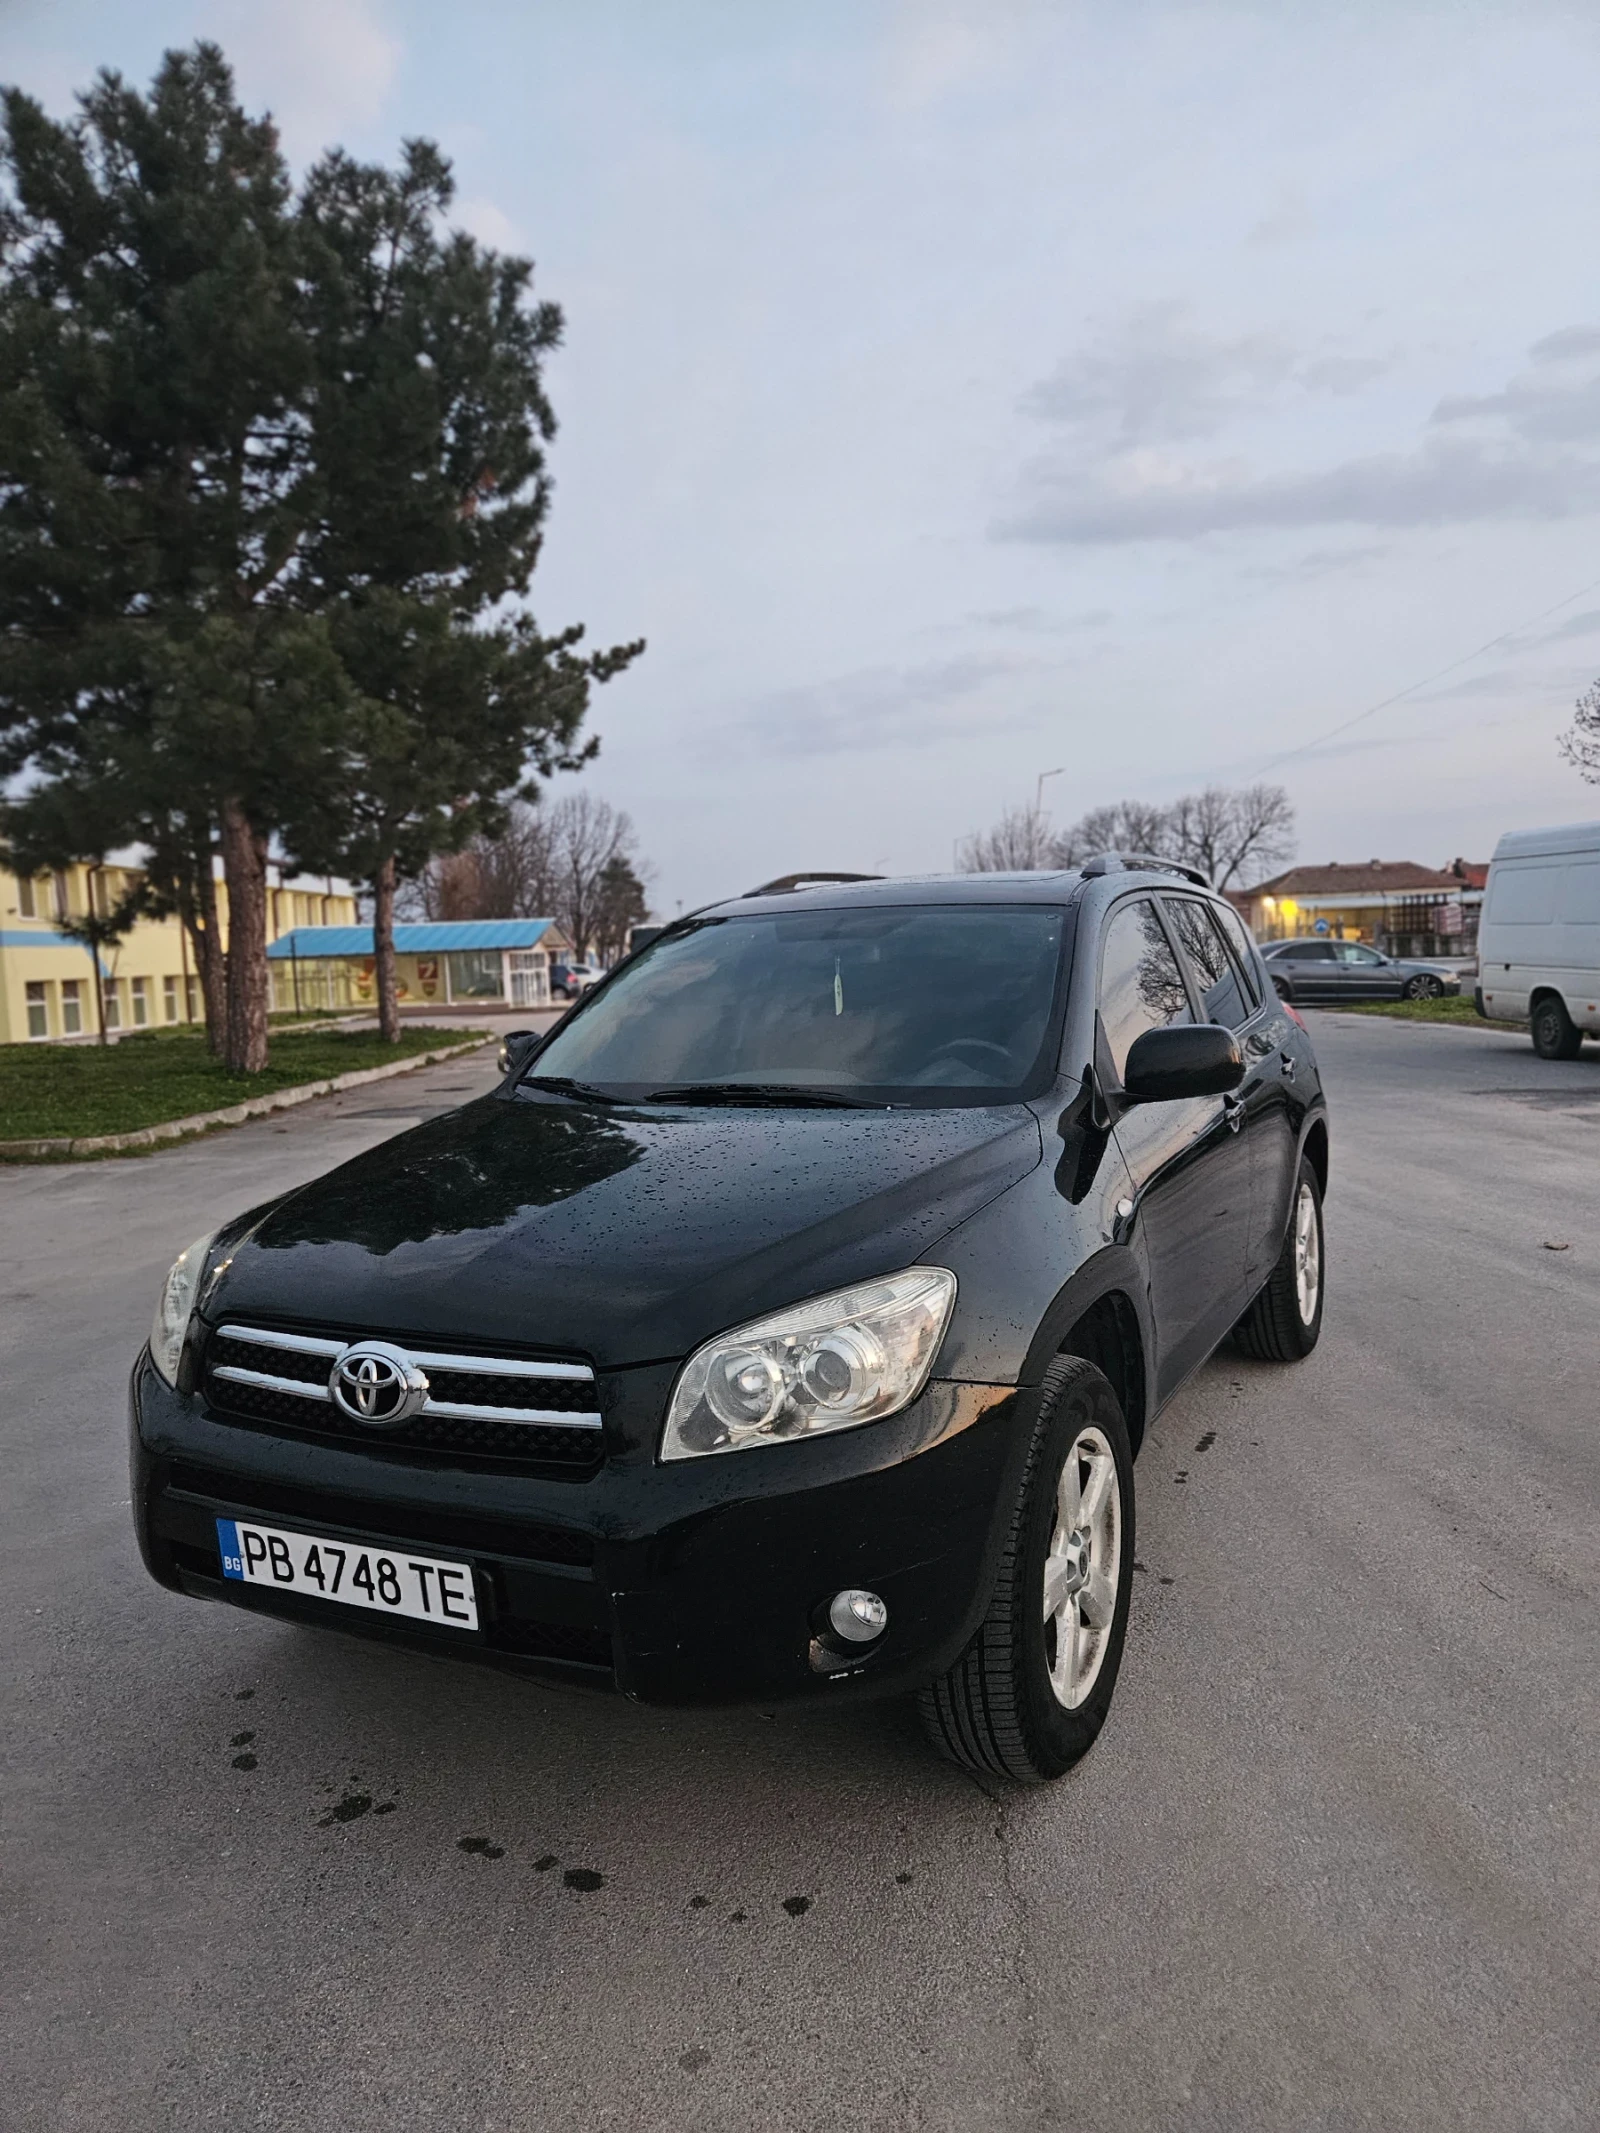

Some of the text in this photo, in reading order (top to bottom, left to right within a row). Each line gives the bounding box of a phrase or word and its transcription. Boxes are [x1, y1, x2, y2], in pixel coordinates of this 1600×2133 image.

[224, 1555, 241, 1571] BG
[242, 1530, 469, 1621] PB 4748 TE
